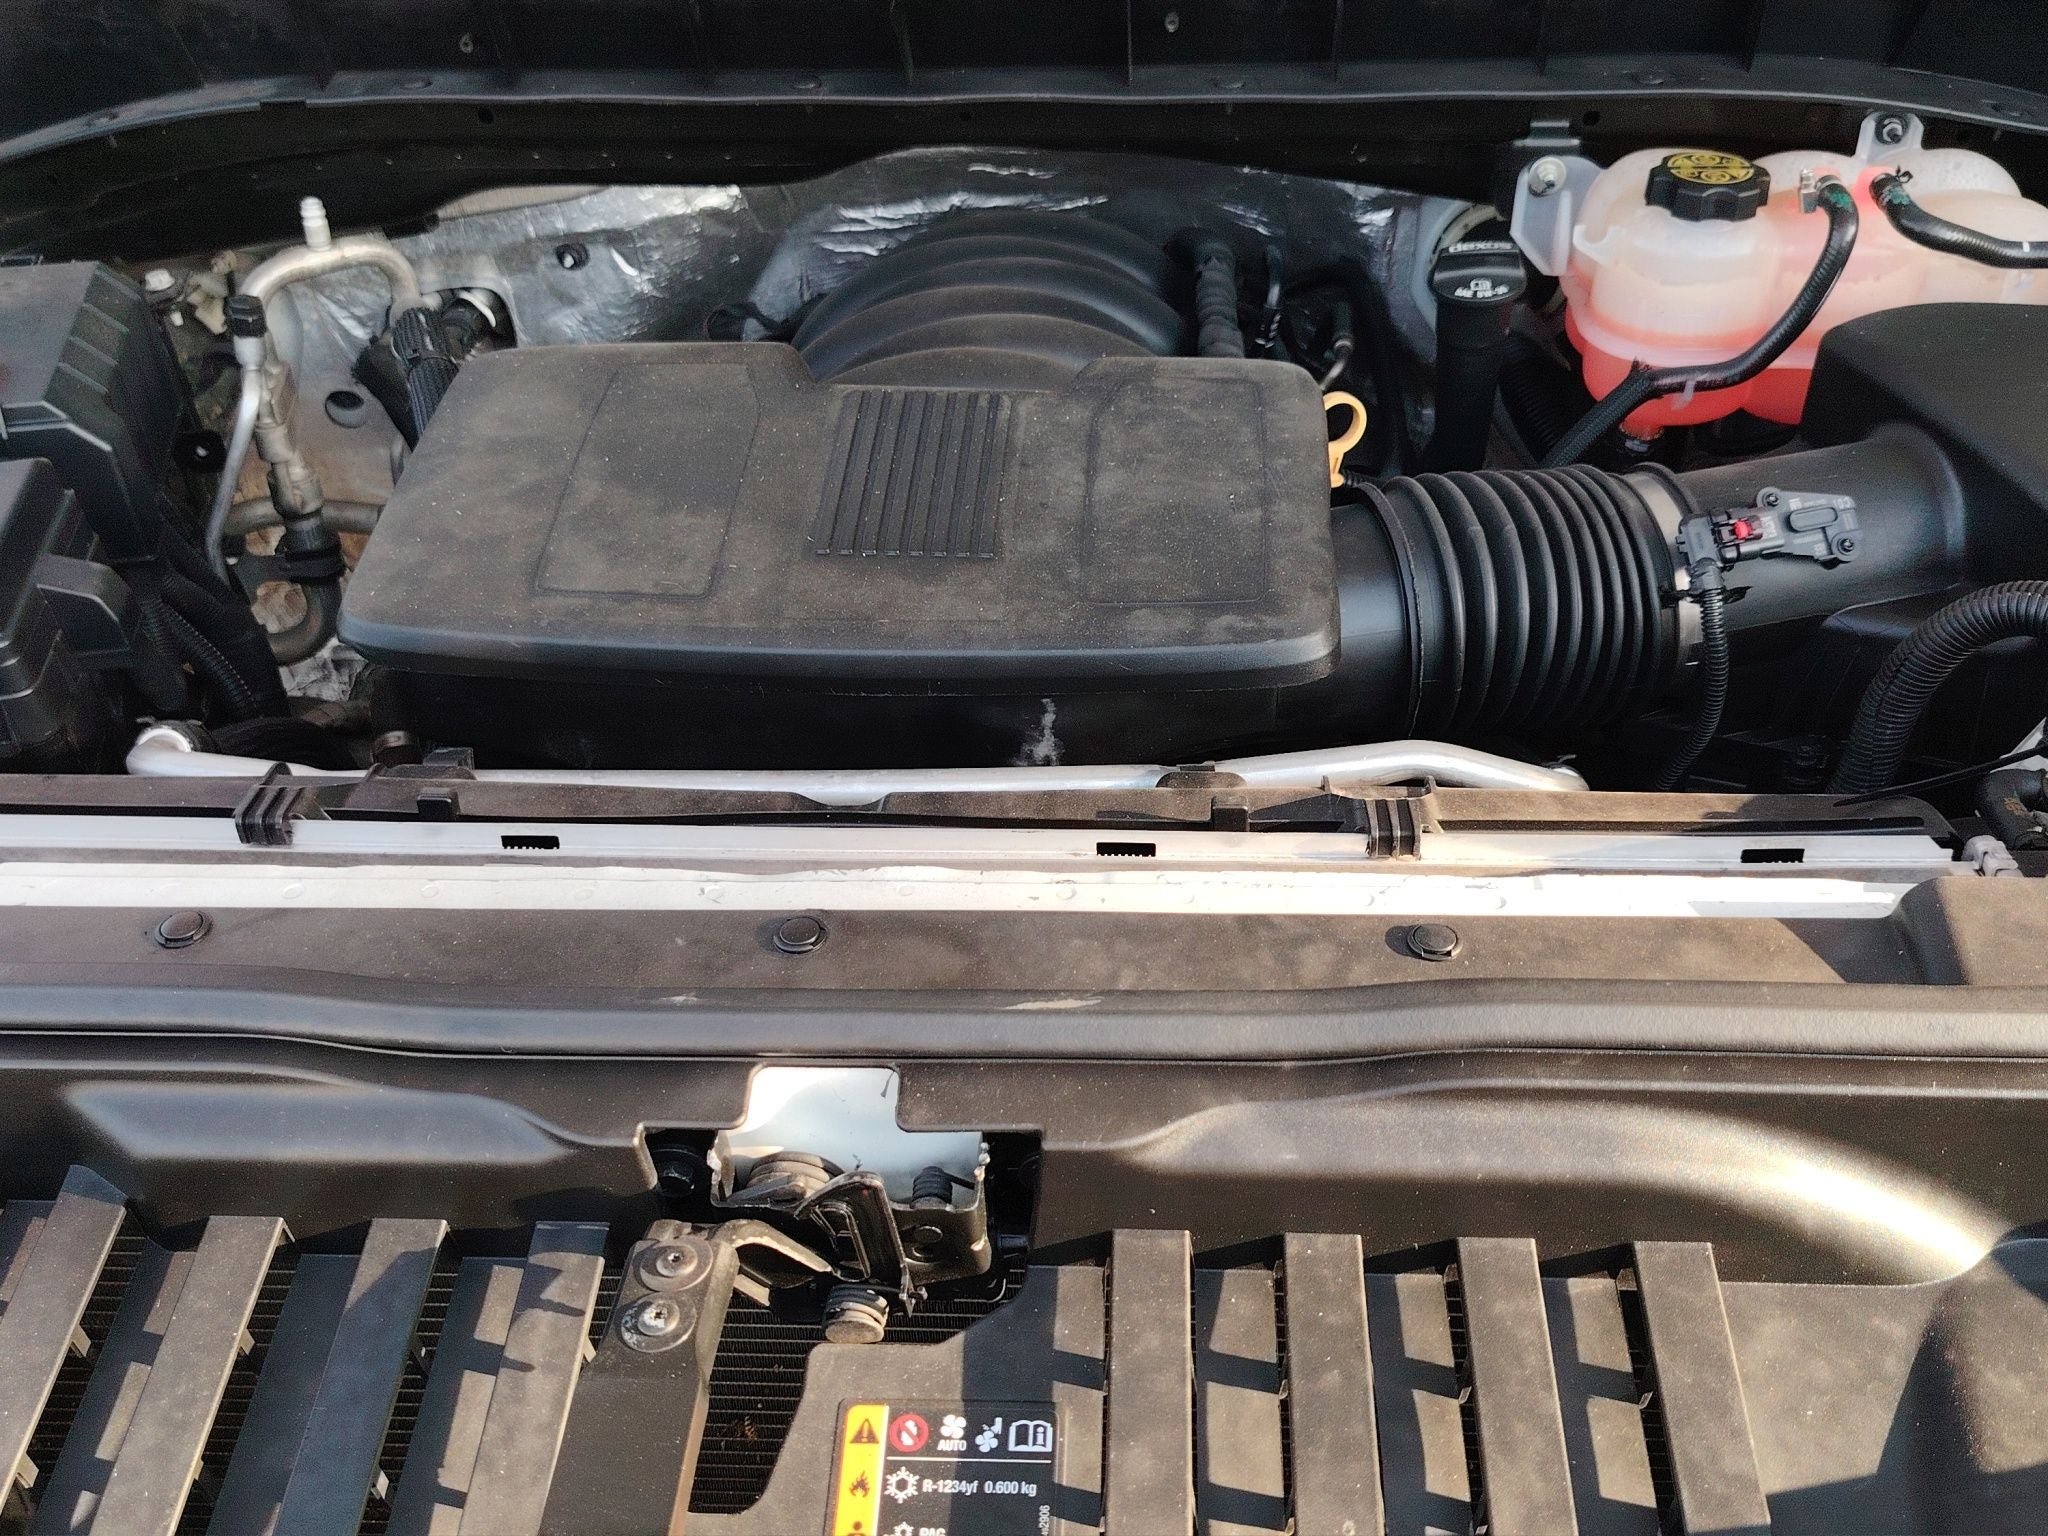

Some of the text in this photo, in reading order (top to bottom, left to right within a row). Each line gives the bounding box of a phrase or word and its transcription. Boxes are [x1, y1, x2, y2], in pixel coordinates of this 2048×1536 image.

[937, 1439, 967, 1451] AUTO
[922, 1479, 1037, 1497] R-1234yf 0.600 kg
